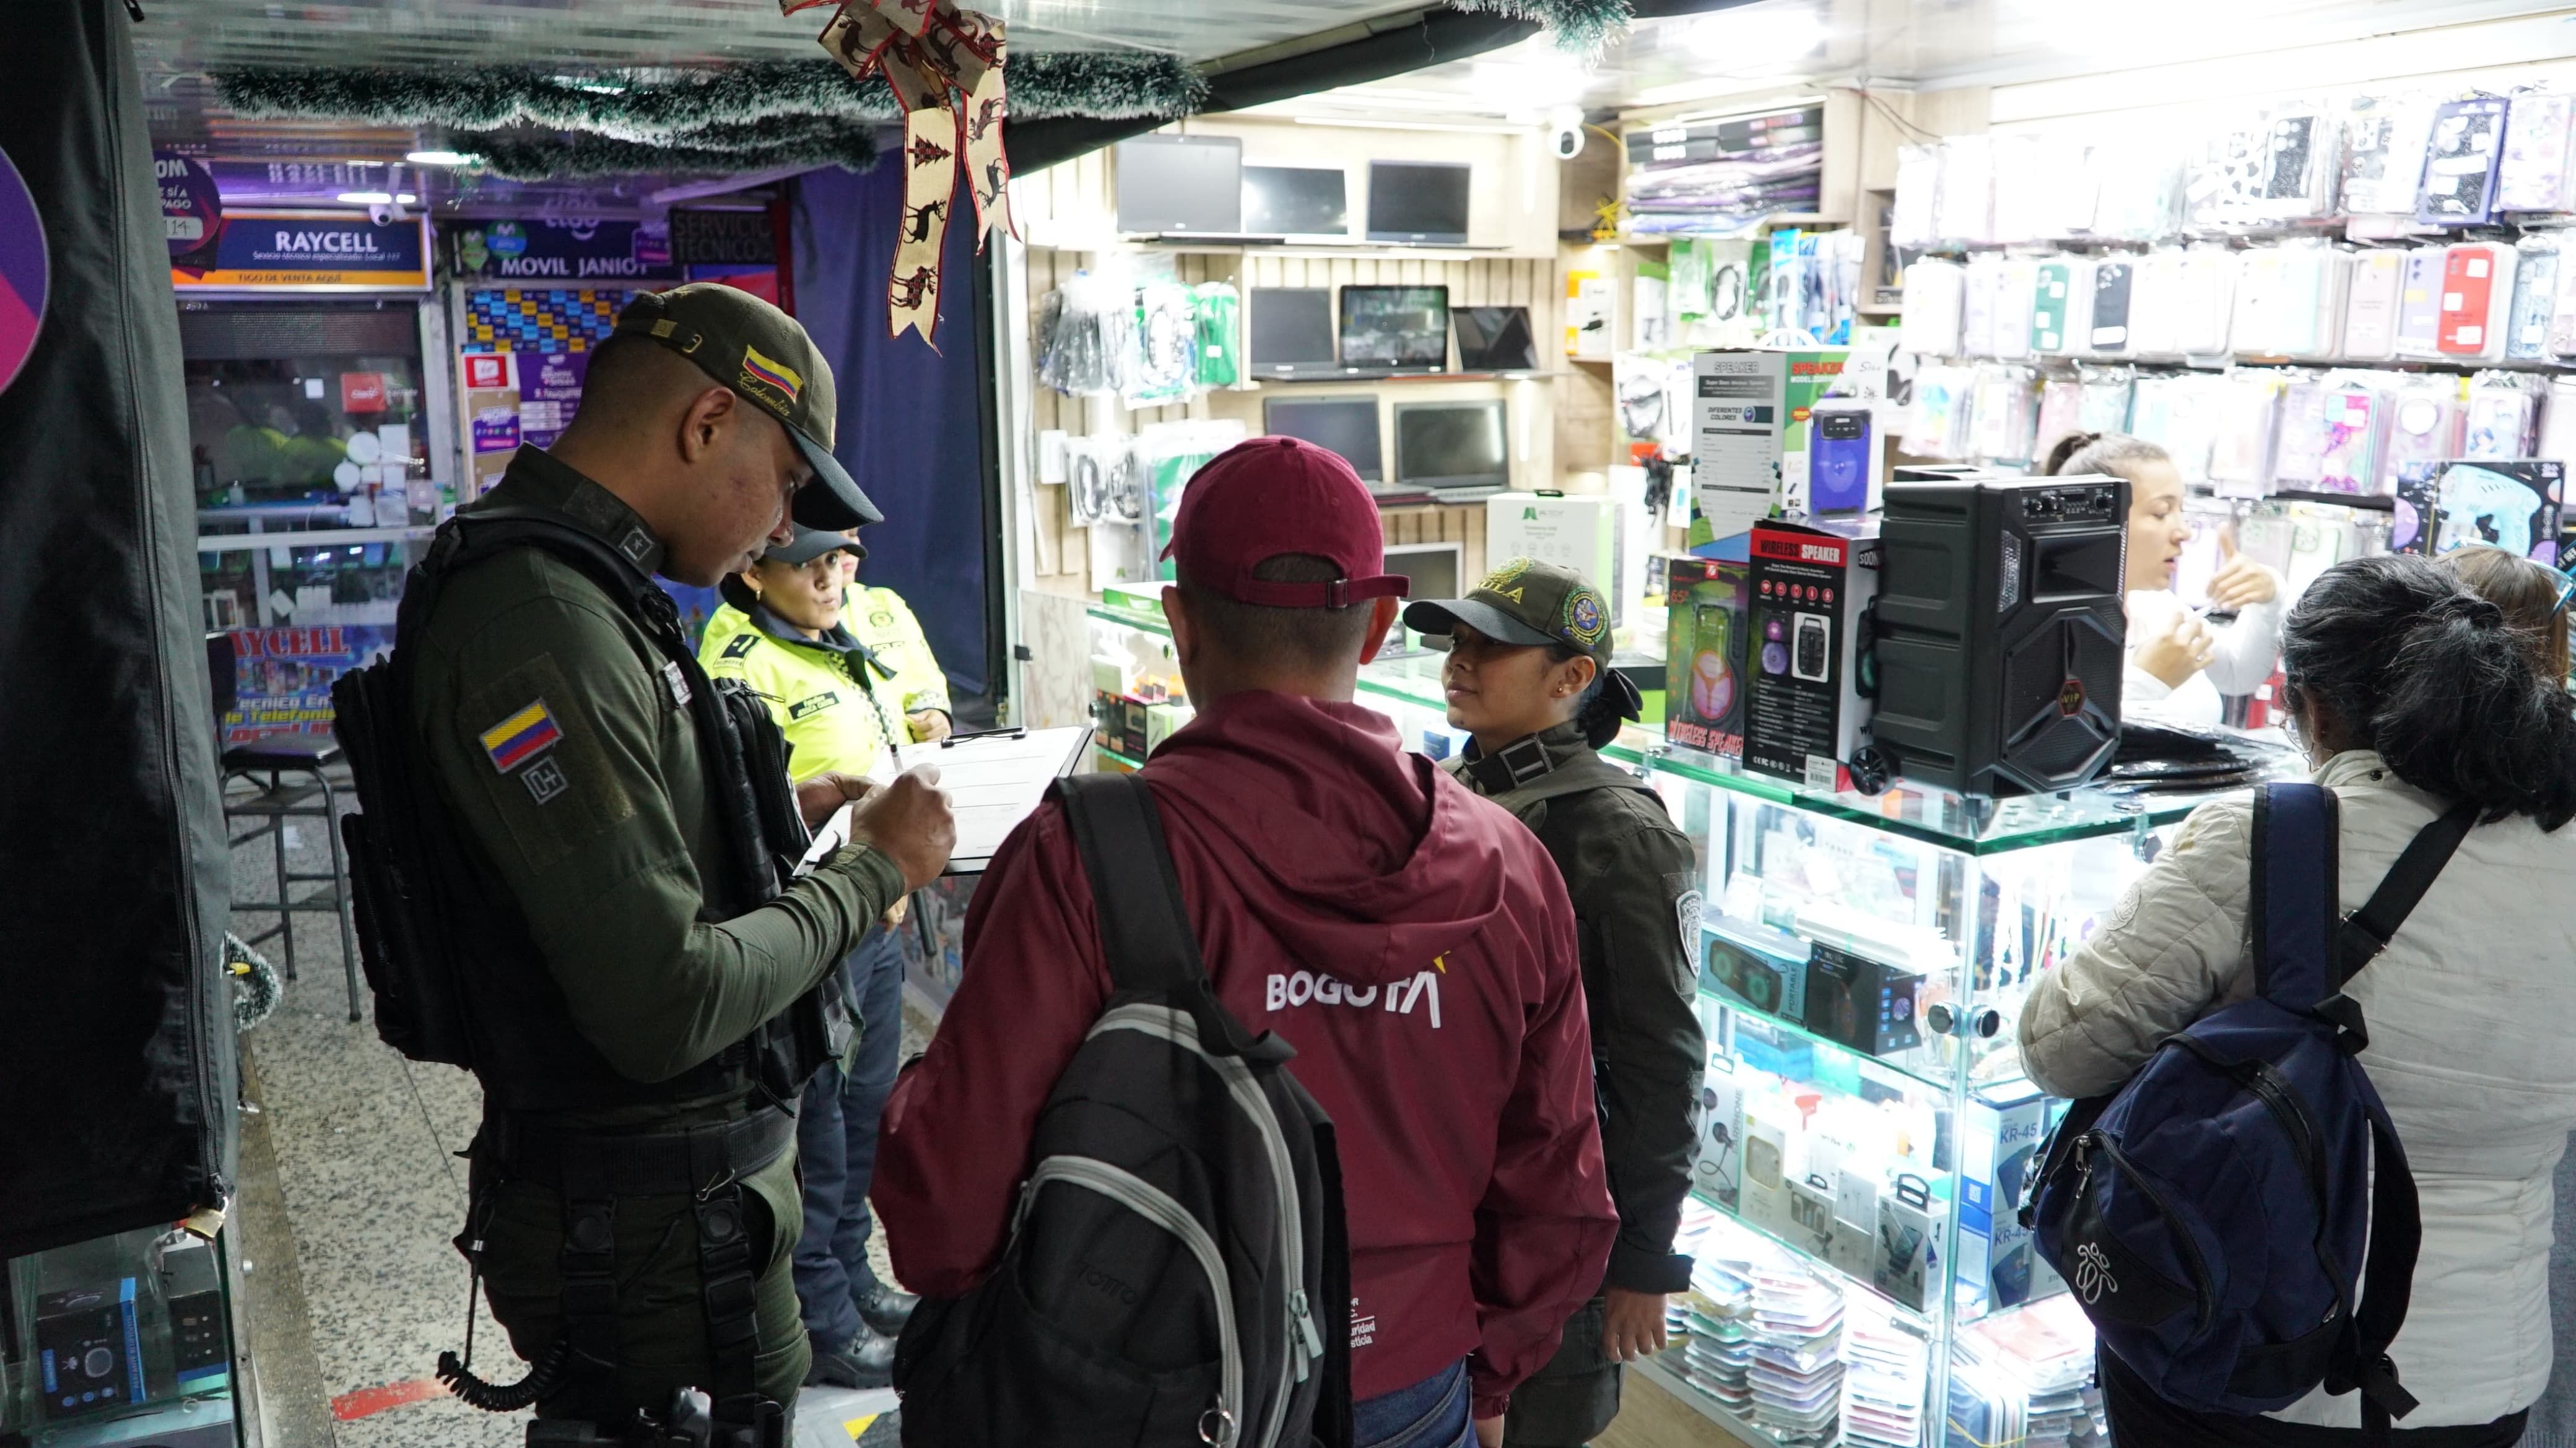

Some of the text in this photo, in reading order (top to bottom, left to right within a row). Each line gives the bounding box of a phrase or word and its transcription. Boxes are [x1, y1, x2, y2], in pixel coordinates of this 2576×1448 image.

[155, 158, 188, 178] OM
[275, 231, 378, 253] RAYCELL
[502, 258, 570, 276] MOVIL
[1715, 361, 1759, 373] SPEAKER
[1791, 362, 1843, 375] SPEAKER
[736, 370, 791, 417] Colombia
[1760, 539, 1840, 563] WIRELESS SPEAKER
[1788, 967, 1798, 1012] PORTABLE
[1999, 1122, 2038, 1145] KR-45
[1351, 1334, 1373, 1348] sticia
